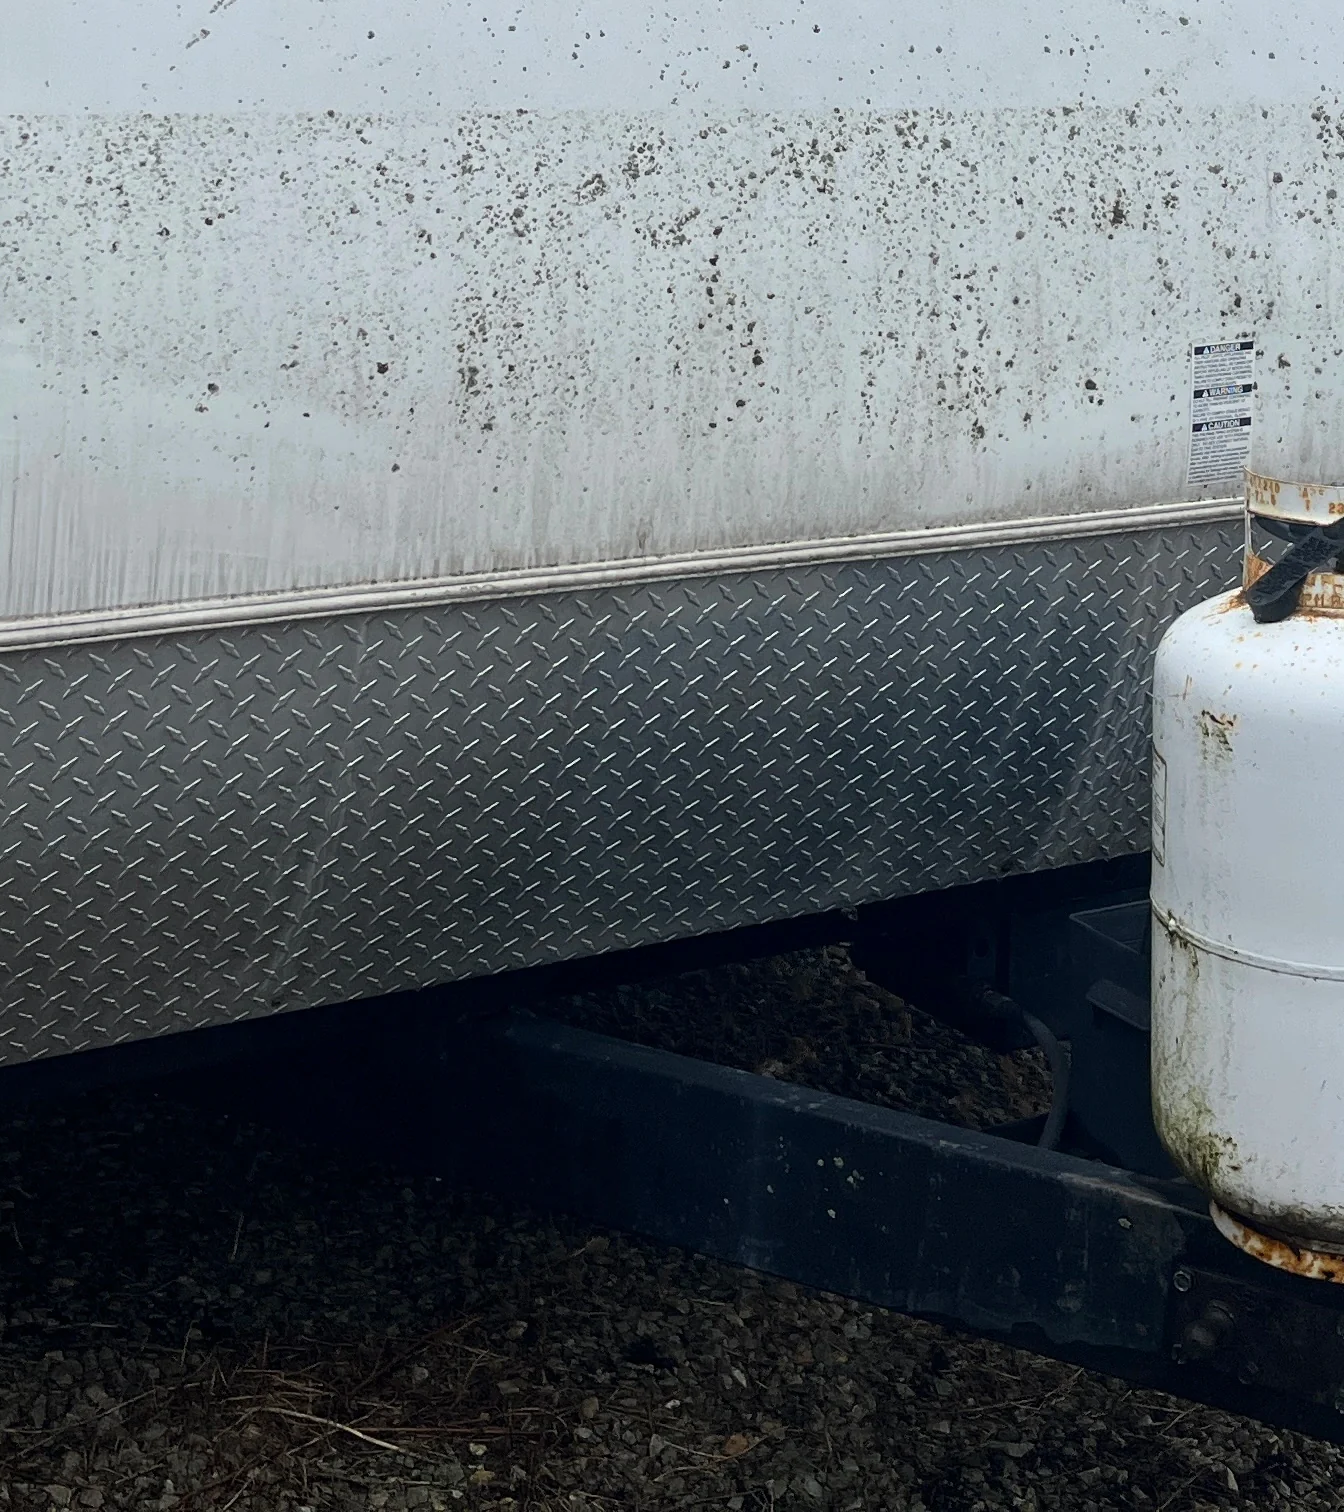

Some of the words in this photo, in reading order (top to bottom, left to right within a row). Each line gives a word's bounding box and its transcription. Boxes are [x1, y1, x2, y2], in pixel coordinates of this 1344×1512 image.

[1210, 343, 1241, 354] DANGER
[1209, 385, 1244, 396] WARNING
[1208, 419, 1240, 430] CAUTION
